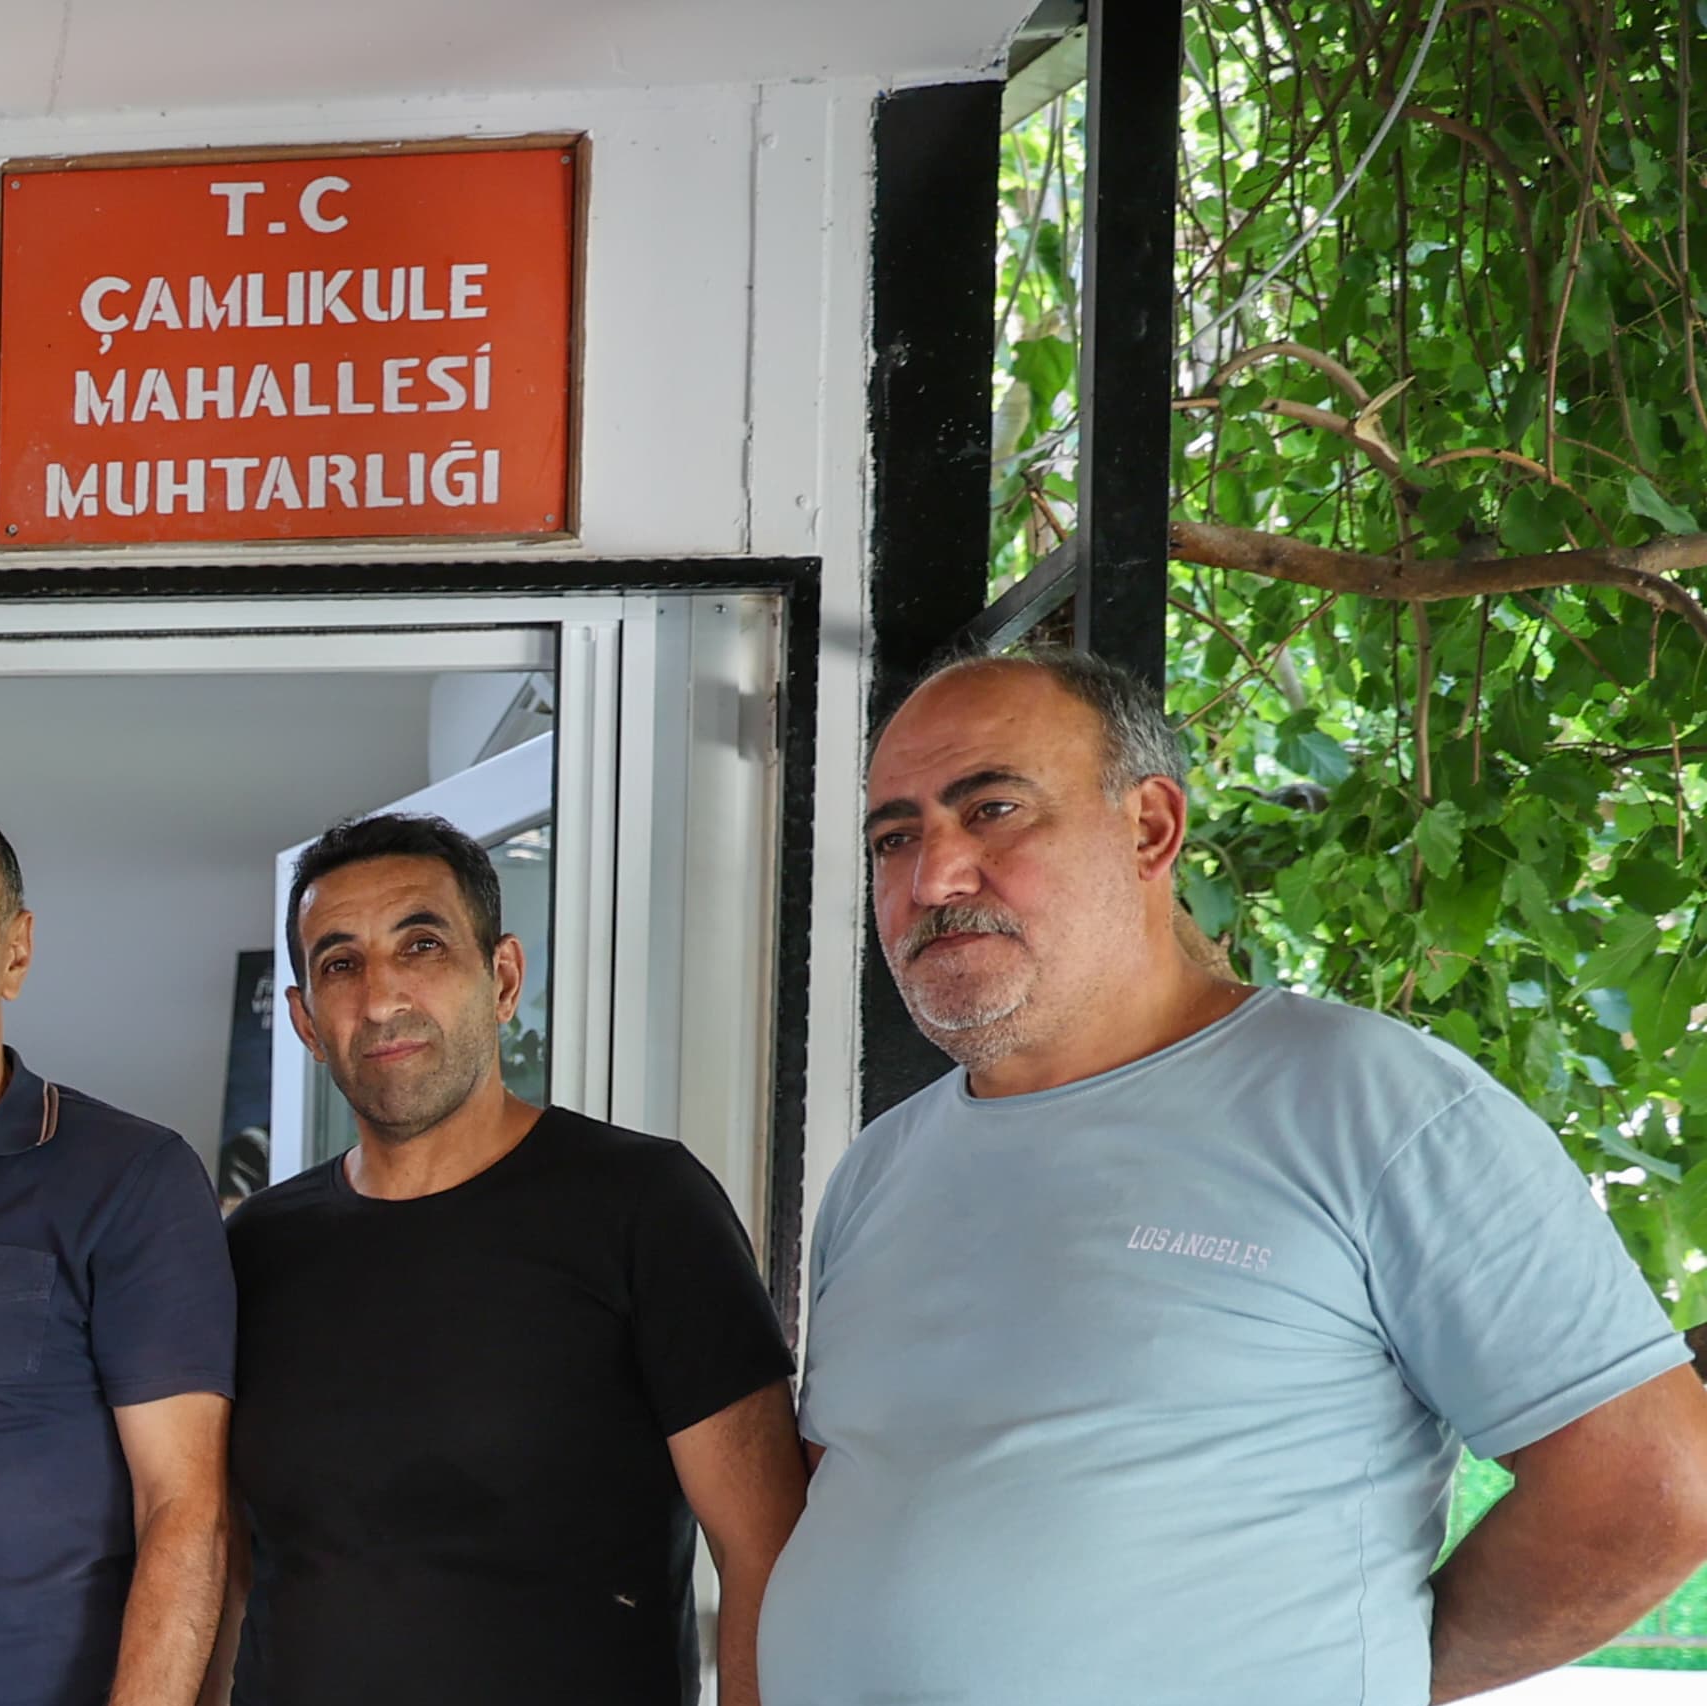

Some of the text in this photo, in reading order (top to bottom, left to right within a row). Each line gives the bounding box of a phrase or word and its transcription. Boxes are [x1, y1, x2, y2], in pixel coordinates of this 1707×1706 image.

[210, 176, 351, 236] T.C
[80, 263, 489, 355] ÇAMLIKULE
[73, 342, 492, 427] MAHALLESİ
[45, 440, 500, 521] MUHTARLIĞI
[1127, 1225, 1272, 1273] LOS ANGELES
